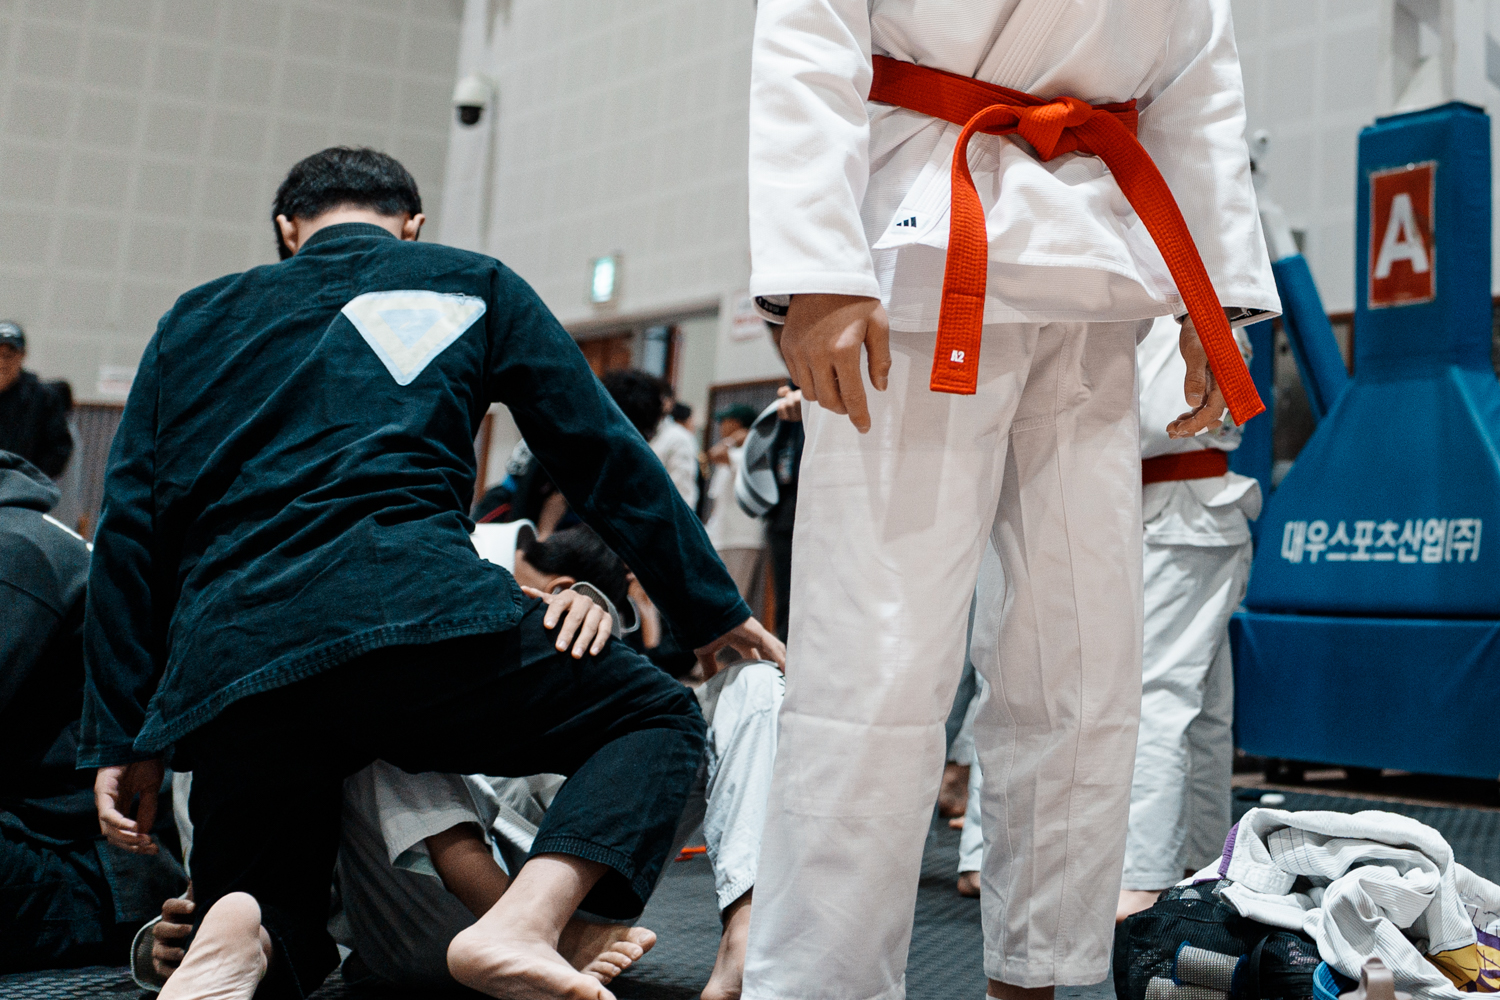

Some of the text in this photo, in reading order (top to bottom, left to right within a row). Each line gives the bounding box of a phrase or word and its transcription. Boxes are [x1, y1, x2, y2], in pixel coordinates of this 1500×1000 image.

[1373, 192, 1430, 280] A
[950, 349, 965, 363] A2
[1280, 517, 1483, 564] 대우스포츠산업(주)
